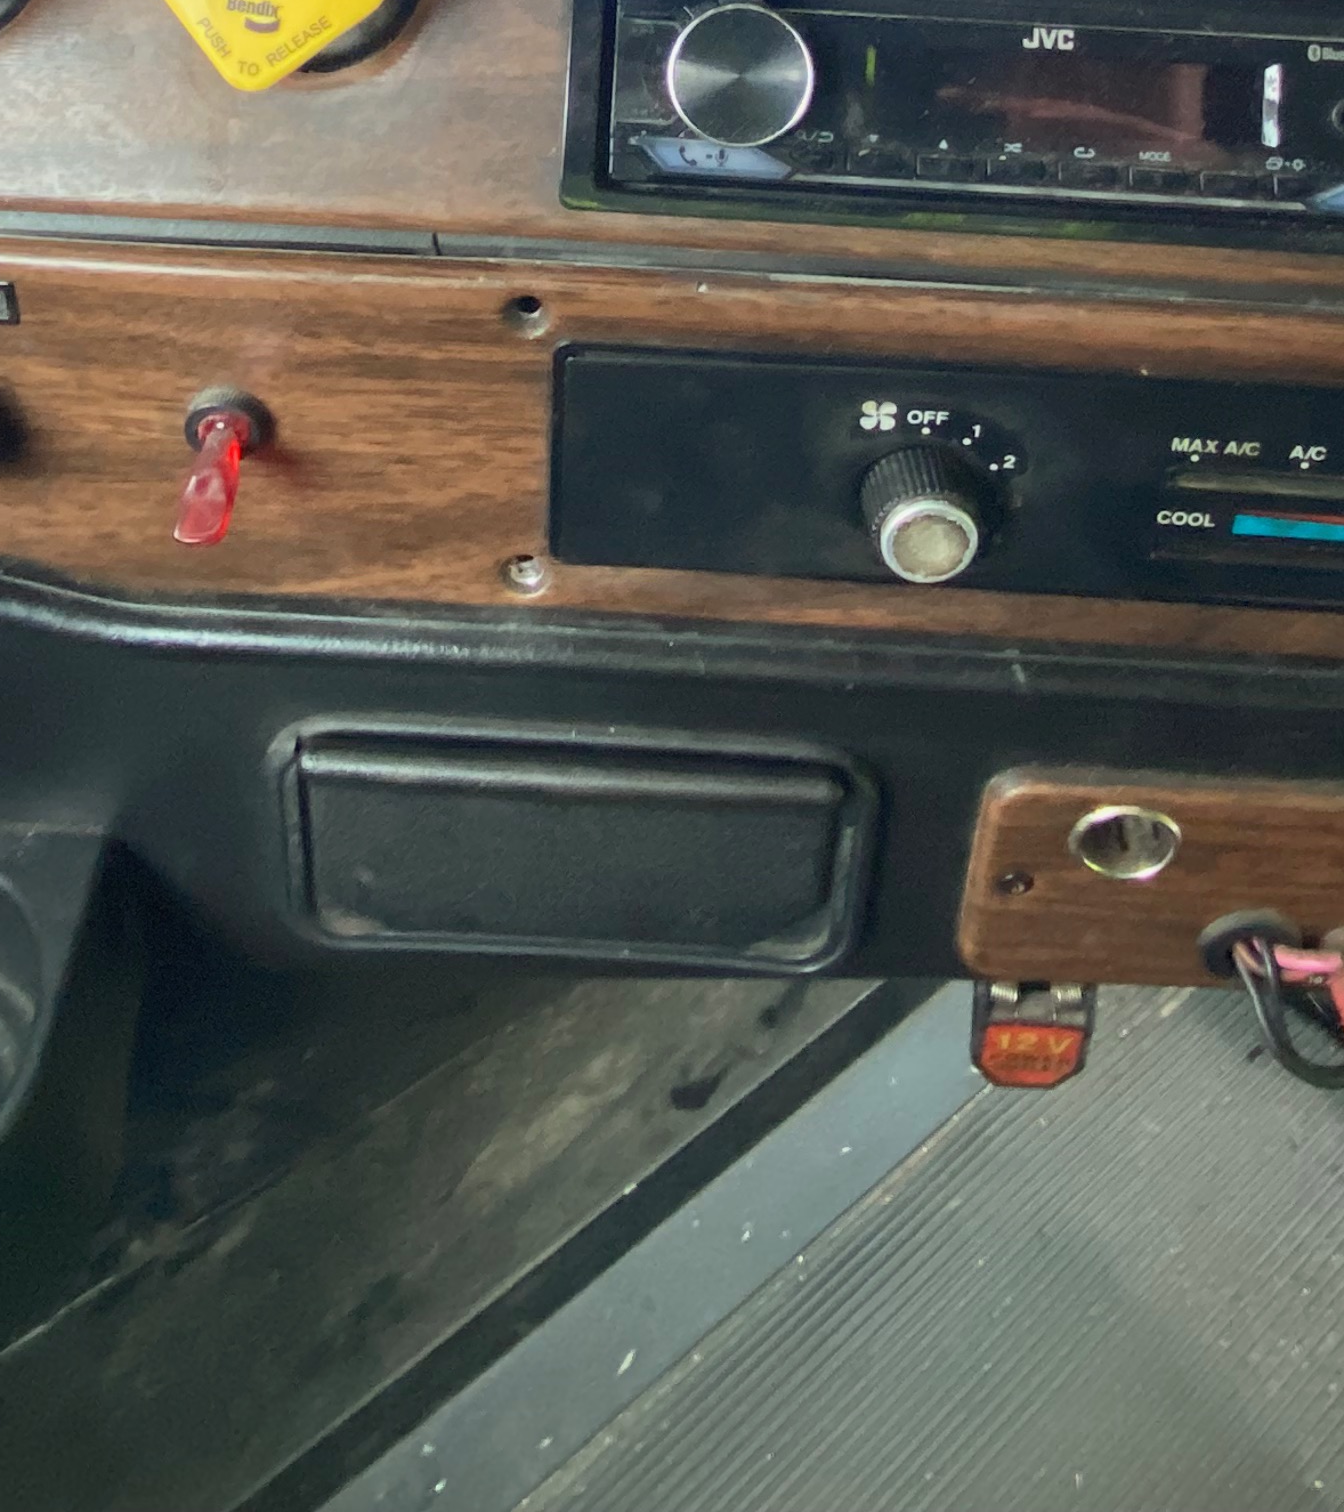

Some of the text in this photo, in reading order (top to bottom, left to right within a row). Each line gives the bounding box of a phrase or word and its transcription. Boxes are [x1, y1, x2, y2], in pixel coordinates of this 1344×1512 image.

[196, 15, 333, 77] PUSH TO RELEASE
[1022, 26, 1074, 52] JVC
[1139, 151, 1172, 162] MODE
[907, 410, 950, 426] OFF
[971, 424, 981, 438] 1
[1171, 437, 1261, 457] MAX A/C
[1289, 445, 1327, 462] A/C
[1003, 455, 1016, 469] 2
[1156, 510, 1216, 528] COOL
[999, 1032, 1074, 1054] 12 V
